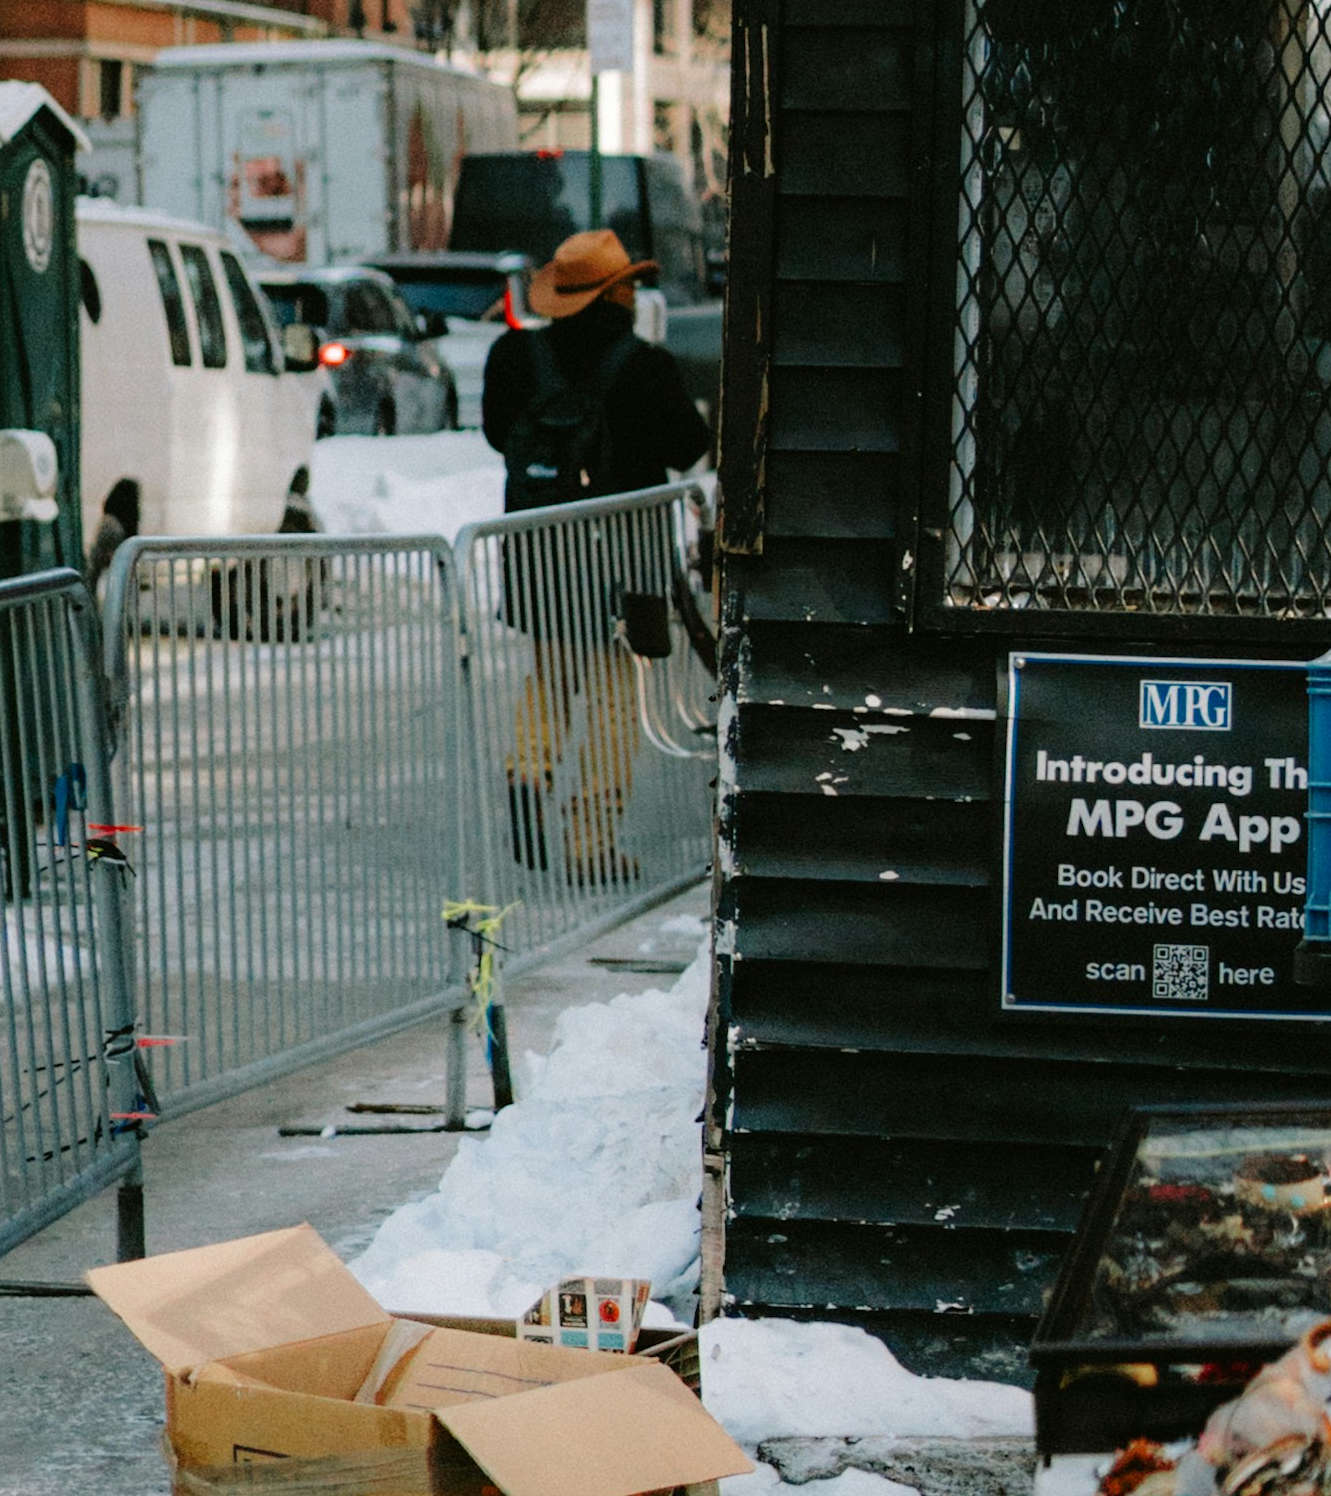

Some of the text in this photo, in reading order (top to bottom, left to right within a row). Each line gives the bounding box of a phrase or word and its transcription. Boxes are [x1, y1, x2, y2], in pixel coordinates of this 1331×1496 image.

[1142, 684, 1228, 727] MPG
[1036, 750, 1309, 796] Introducing Th
[1066, 798, 1301, 854] MPG App
[1057, 863, 1307, 895] Book Direct With Us
[1029, 897, 1078, 921] And
[1085, 899, 1183, 926] Receive
[1190, 903, 1250, 928] Best
[1086, 961, 1275, 986] scan here
